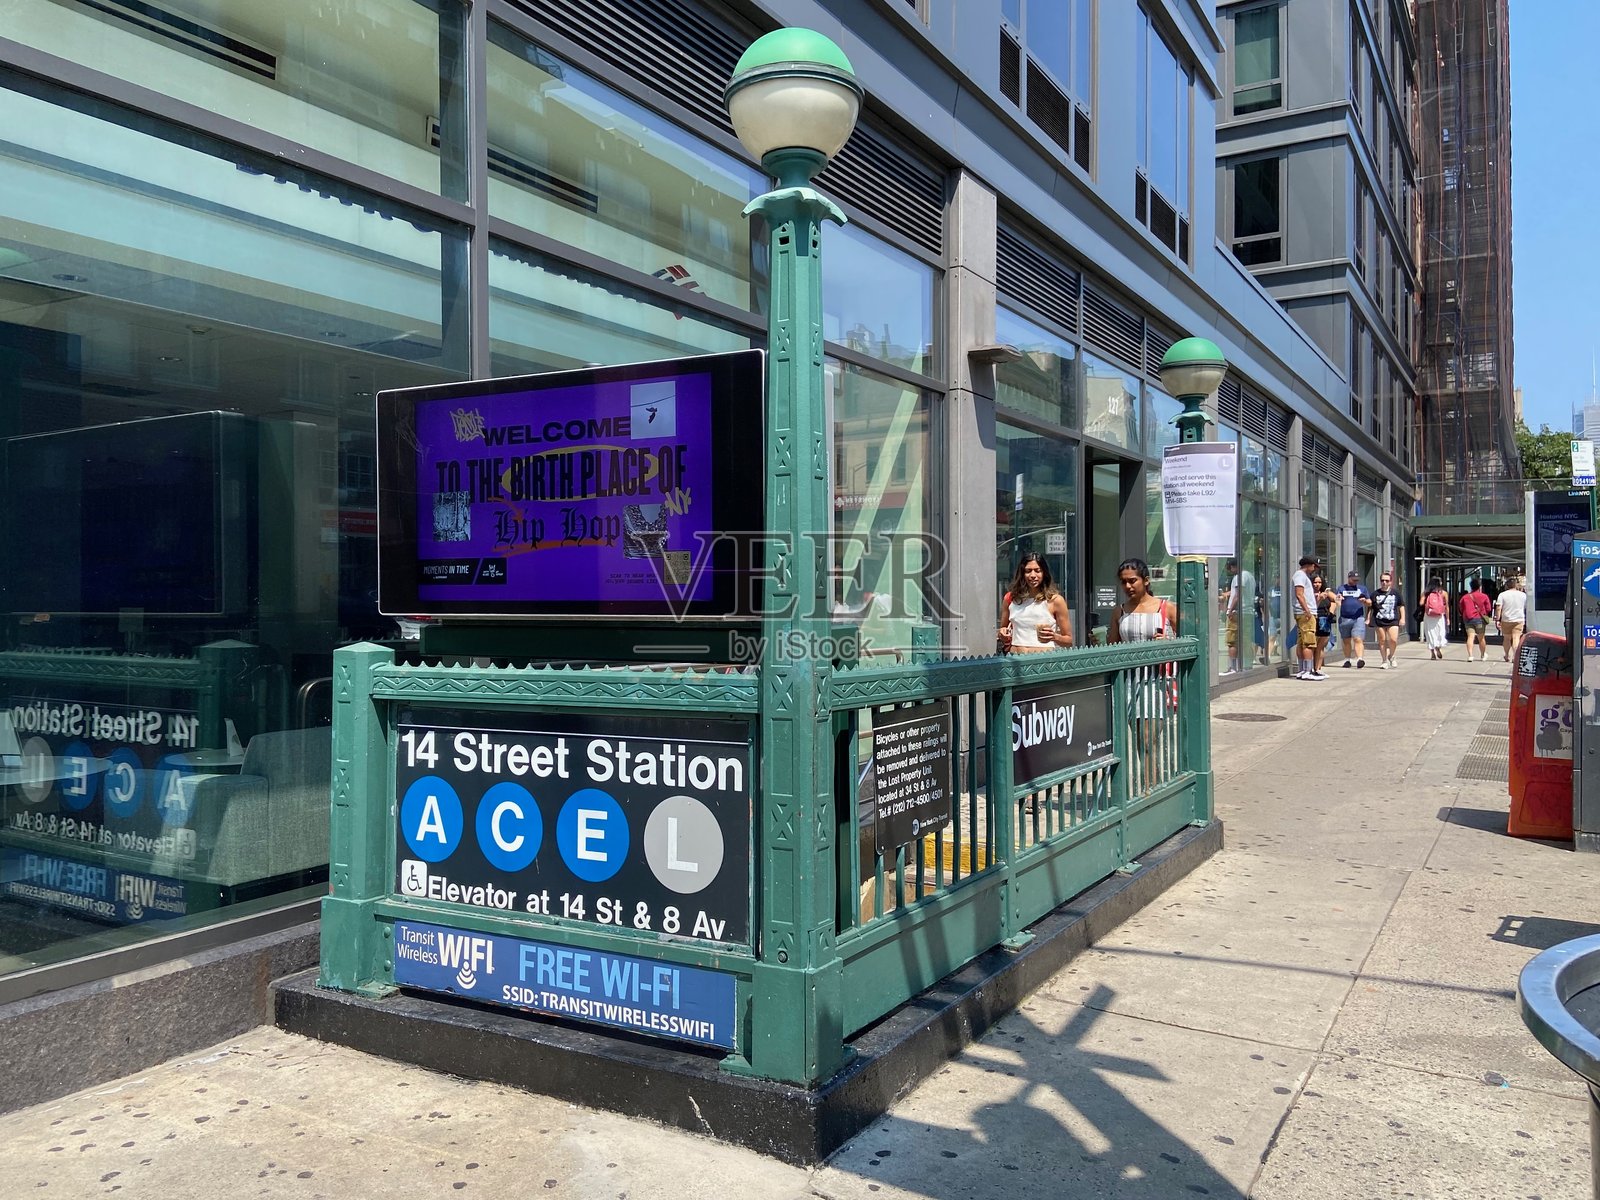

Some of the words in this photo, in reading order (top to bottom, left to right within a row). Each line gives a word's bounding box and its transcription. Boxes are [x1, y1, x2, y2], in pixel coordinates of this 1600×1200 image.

[482, 416, 632, 447] WELCOME
[435, 460, 460, 493] TO
[466, 457, 504, 504] THE
[510, 452, 574, 502] BIRTH
[580, 447, 651, 499] PLACE
[658, 444, 688, 495] OF
[665, 487, 692, 517] NY
[494, 507, 545, 550] Hip
[559, 506, 621, 549] Hop
[423, 565, 449, 575] MOMENTS
[449, 565, 456, 574] IN
[456, 565, 470, 574] TIME
[876, 731, 899, 745] Bicycles
[900, 731, 905, 740] or
[906, 727, 919, 738] other
[920, 723, 940, 736] property
[1011, 702, 1075, 752] Subway
[401, 729, 439, 769] 14
[453, 731, 570, 779] Street
[586, 738, 743, 792] Station
[876, 744, 900, 760] attached
[901, 744, 907, 753] to
[908, 741, 922, 752] these
[923, 737, 939, 748] railings
[876, 764, 885, 775] be
[886, 757, 908, 772] removed
[908, 754, 918, 766] and
[919, 748, 940, 763] delivered
[941, 748, 947, 756] to
[877, 778, 887, 789] the
[888, 774, 900, 787] Lost
[901, 768, 922, 782] Property
[923, 764, 932, 776] Unit
[877, 789, 898, 804] located
[899, 787, 904, 798] at
[905, 784, 912, 796] 34
[913, 782, 919, 793] St
[892, 800, 906, 815] (212)
[415, 795, 448, 844] A
[491, 801, 525, 852] C
[577, 808, 609, 862] E
[667, 816, 699, 873] L
[428, 874, 517, 910] Elevator
[526, 889, 550, 915] at
[559, 892, 586, 920] 14
[596, 896, 623, 926] St
[634, 900, 651, 930] &
[663, 905, 681, 934] 8
[692, 910, 726, 940] Av
[400, 925, 435, 946] Transit
[397, 942, 438, 965] Wireless
[518, 943, 591, 994] FREE
[600, 957, 680, 1010] WI-FI
[502, 984, 539, 1007] SSID:
[541, 991, 715, 1041] TRANSITWIRELESSWIFI
